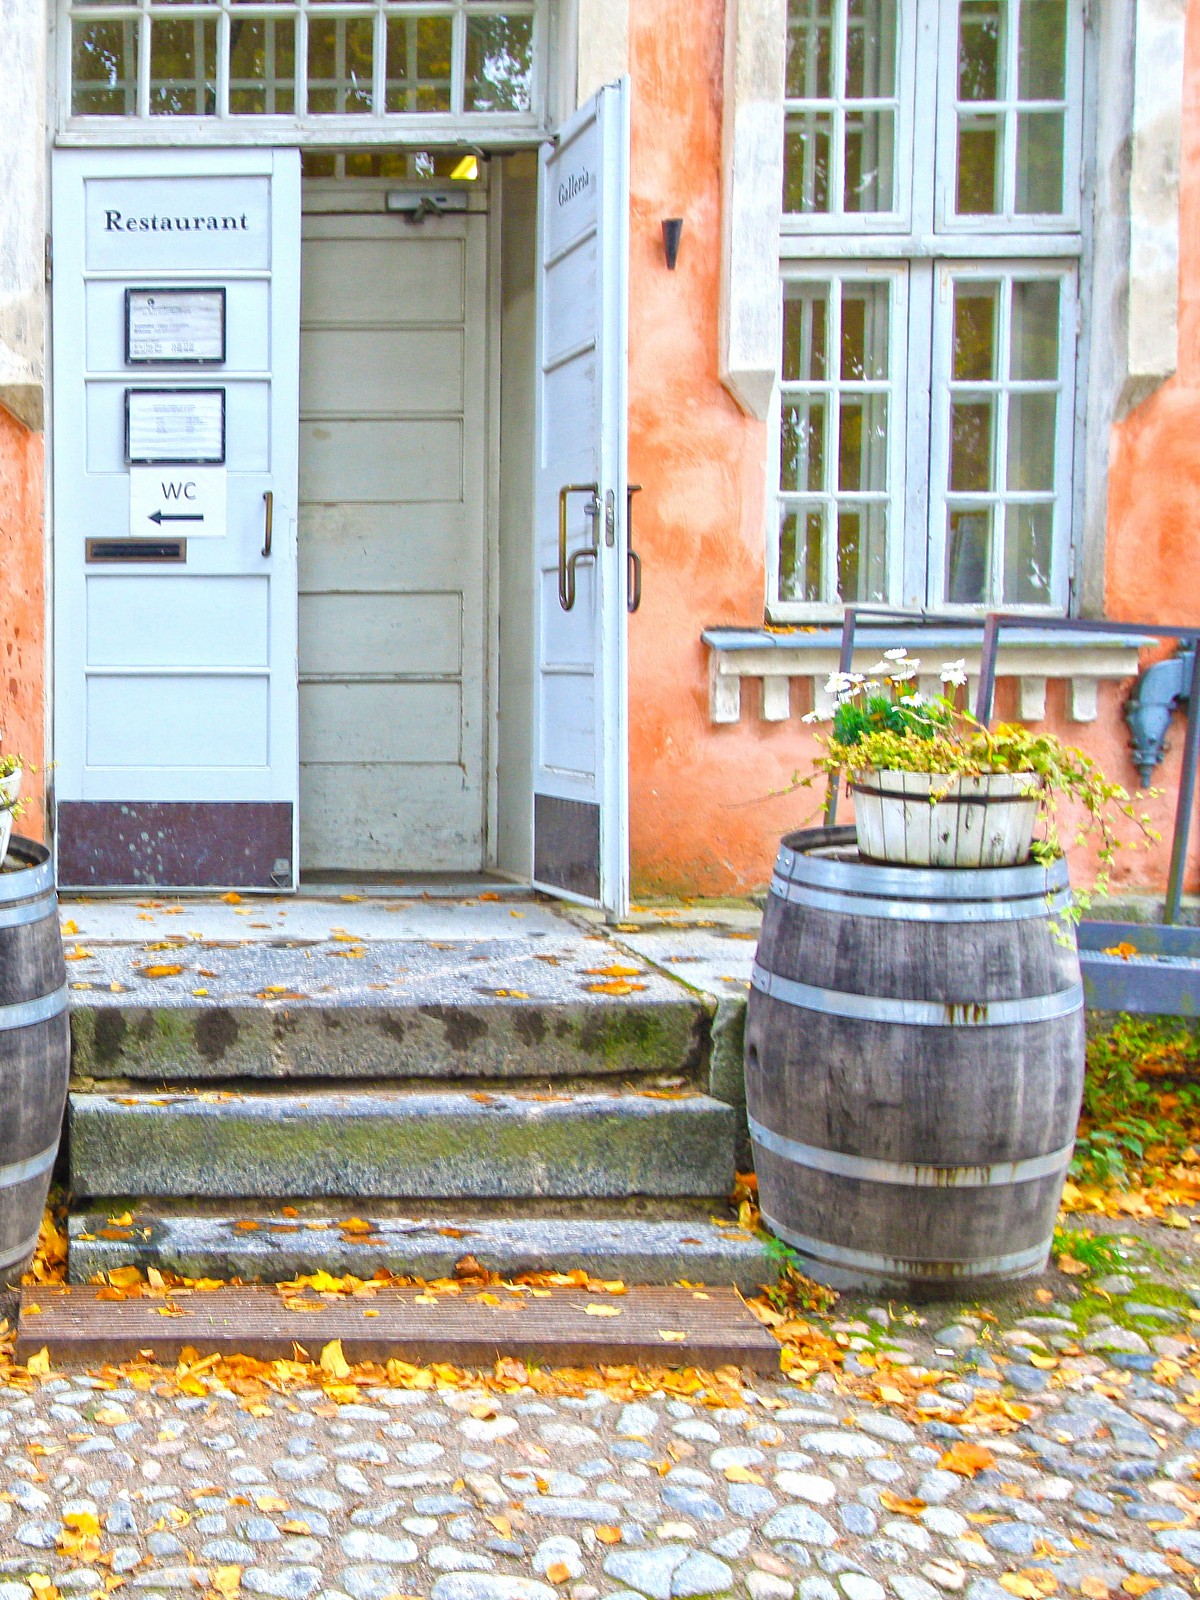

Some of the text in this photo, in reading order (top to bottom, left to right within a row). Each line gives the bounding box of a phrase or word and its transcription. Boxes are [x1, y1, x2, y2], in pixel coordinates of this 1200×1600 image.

[558, 165, 589, 207] Galleria
[104, 209, 250, 232] Restaurant
[161, 481, 197, 501] WC
